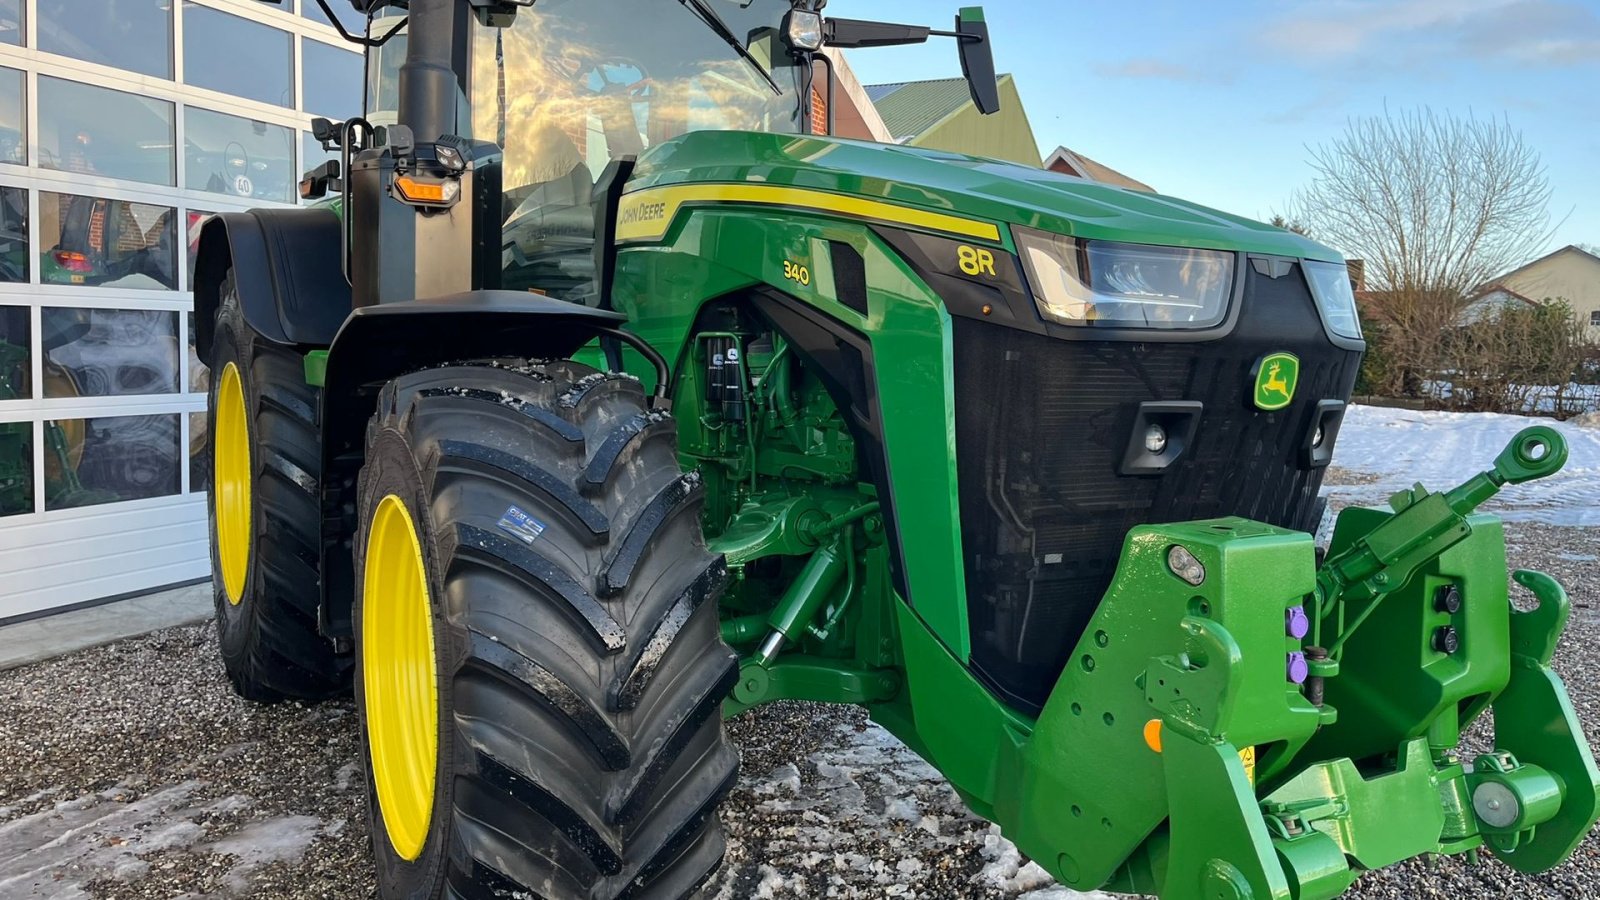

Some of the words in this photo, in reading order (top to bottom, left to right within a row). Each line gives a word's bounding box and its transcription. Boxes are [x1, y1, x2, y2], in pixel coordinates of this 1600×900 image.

[238, 178, 250, 193] 40
[620, 207, 638, 225] JOHN
[638, 202, 666, 221] DEERE
[957, 245, 996, 276] 8R
[783, 260, 810, 286] 340
